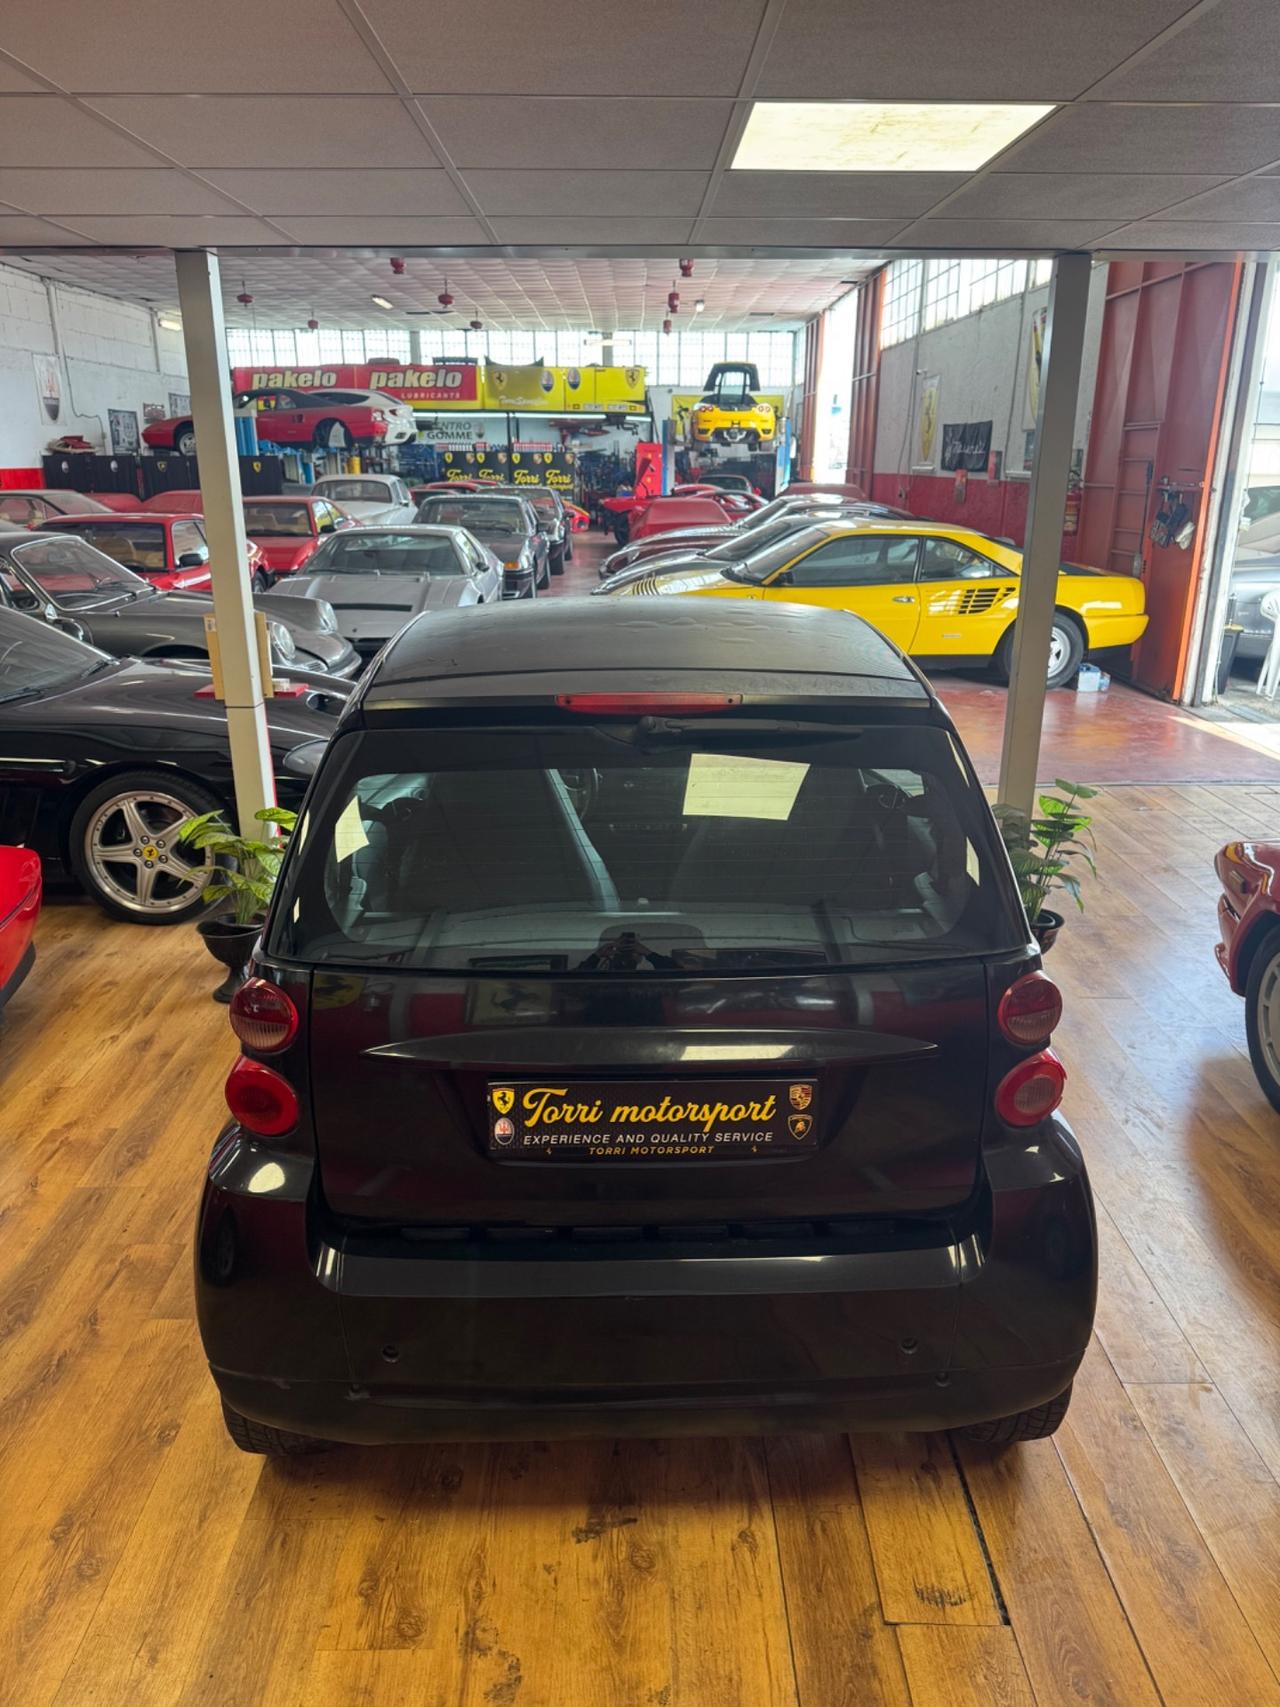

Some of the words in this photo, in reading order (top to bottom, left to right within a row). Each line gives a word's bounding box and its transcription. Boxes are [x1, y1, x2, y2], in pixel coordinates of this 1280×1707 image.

[252, 369, 338, 390] pakelo
[369, 368, 463, 390] pakelo
[401, 392, 461, 400] LUBRICANTS
[432, 421, 472, 430] ENTRO
[427, 431, 473, 440] GOMME
[513, 469, 540, 485] Torri
[545, 469, 572, 485] Torri
[522, 1087, 604, 1128] Torri
[609, 1094, 777, 1133] motorsport
[523, 1134, 611, 1145] EXPERIENCE
[615, 1133, 645, 1144] AND
[650, 1132, 711, 1144] QUALITY
[714, 1131, 774, 1142] SERVICE
[589, 1147, 626, 1155] TORRI
[630, 1145, 715, 1155] MOTORSPORT
